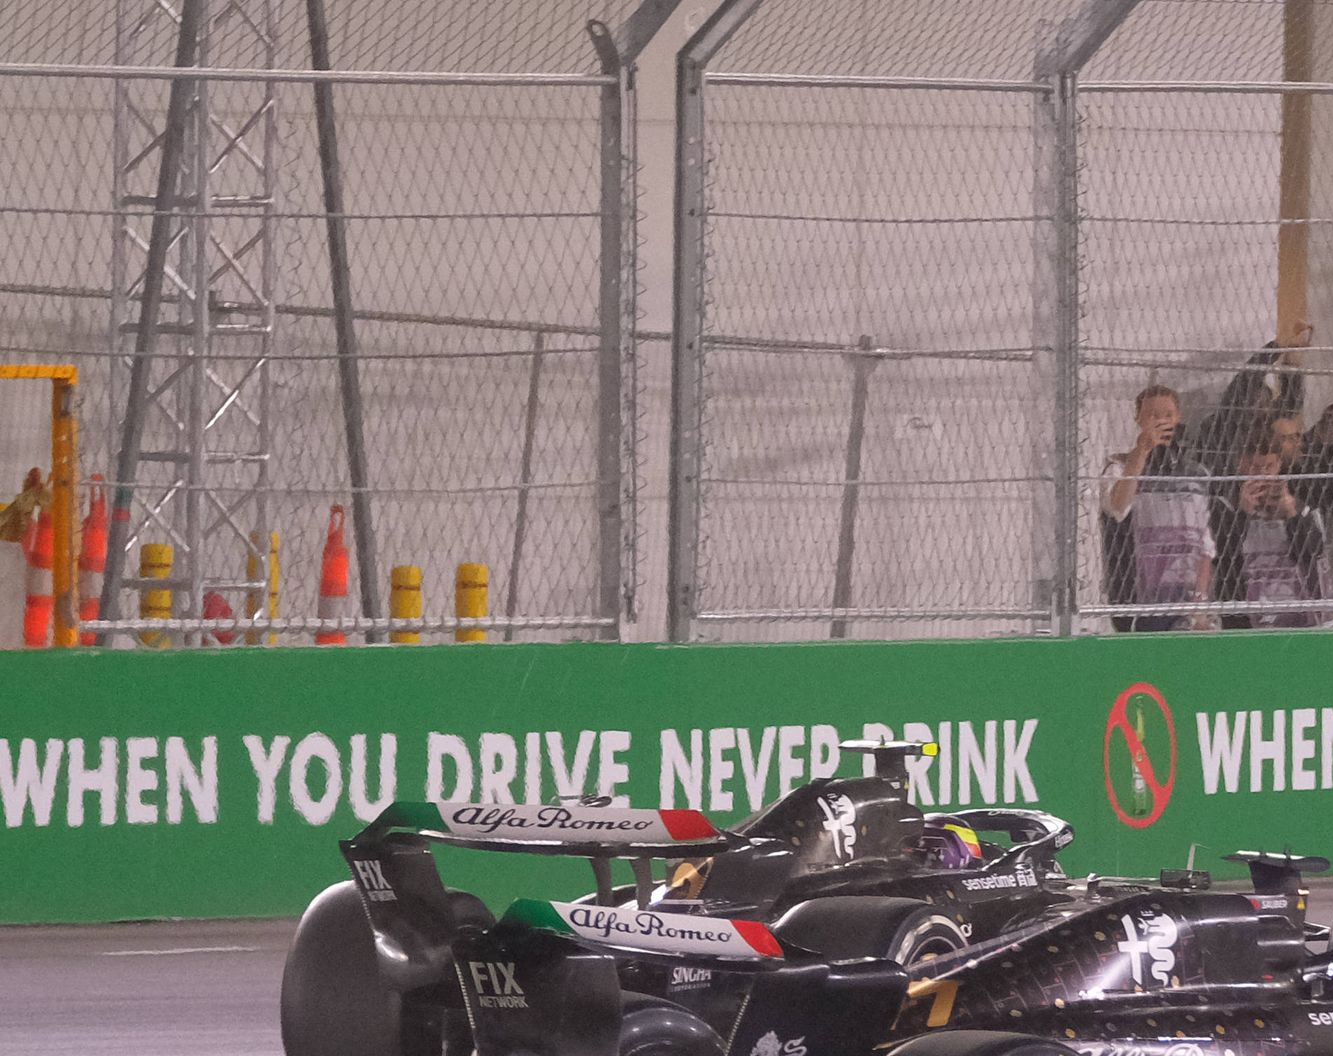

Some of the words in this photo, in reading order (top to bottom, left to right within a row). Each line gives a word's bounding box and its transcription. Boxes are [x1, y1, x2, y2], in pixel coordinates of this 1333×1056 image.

[0, 735, 218, 828] WHEN
[241, 732, 399, 827] YOU
[426, 730, 633, 812] DRIVE
[659, 724, 842, 812] NEVER
[862, 719, 1040, 807] DRINK
[453, 805, 535, 833] Alfa
[537, 807, 654, 832] Romeo
[354, 860, 393, 890] FIX
[962, 873, 1016, 890] sensetime
[569, 908, 637, 938] Alfa
[638, 912, 733, 943] Romeo
[469, 961, 525, 995] FIX
[479, 995, 529, 1008] NETWORK
